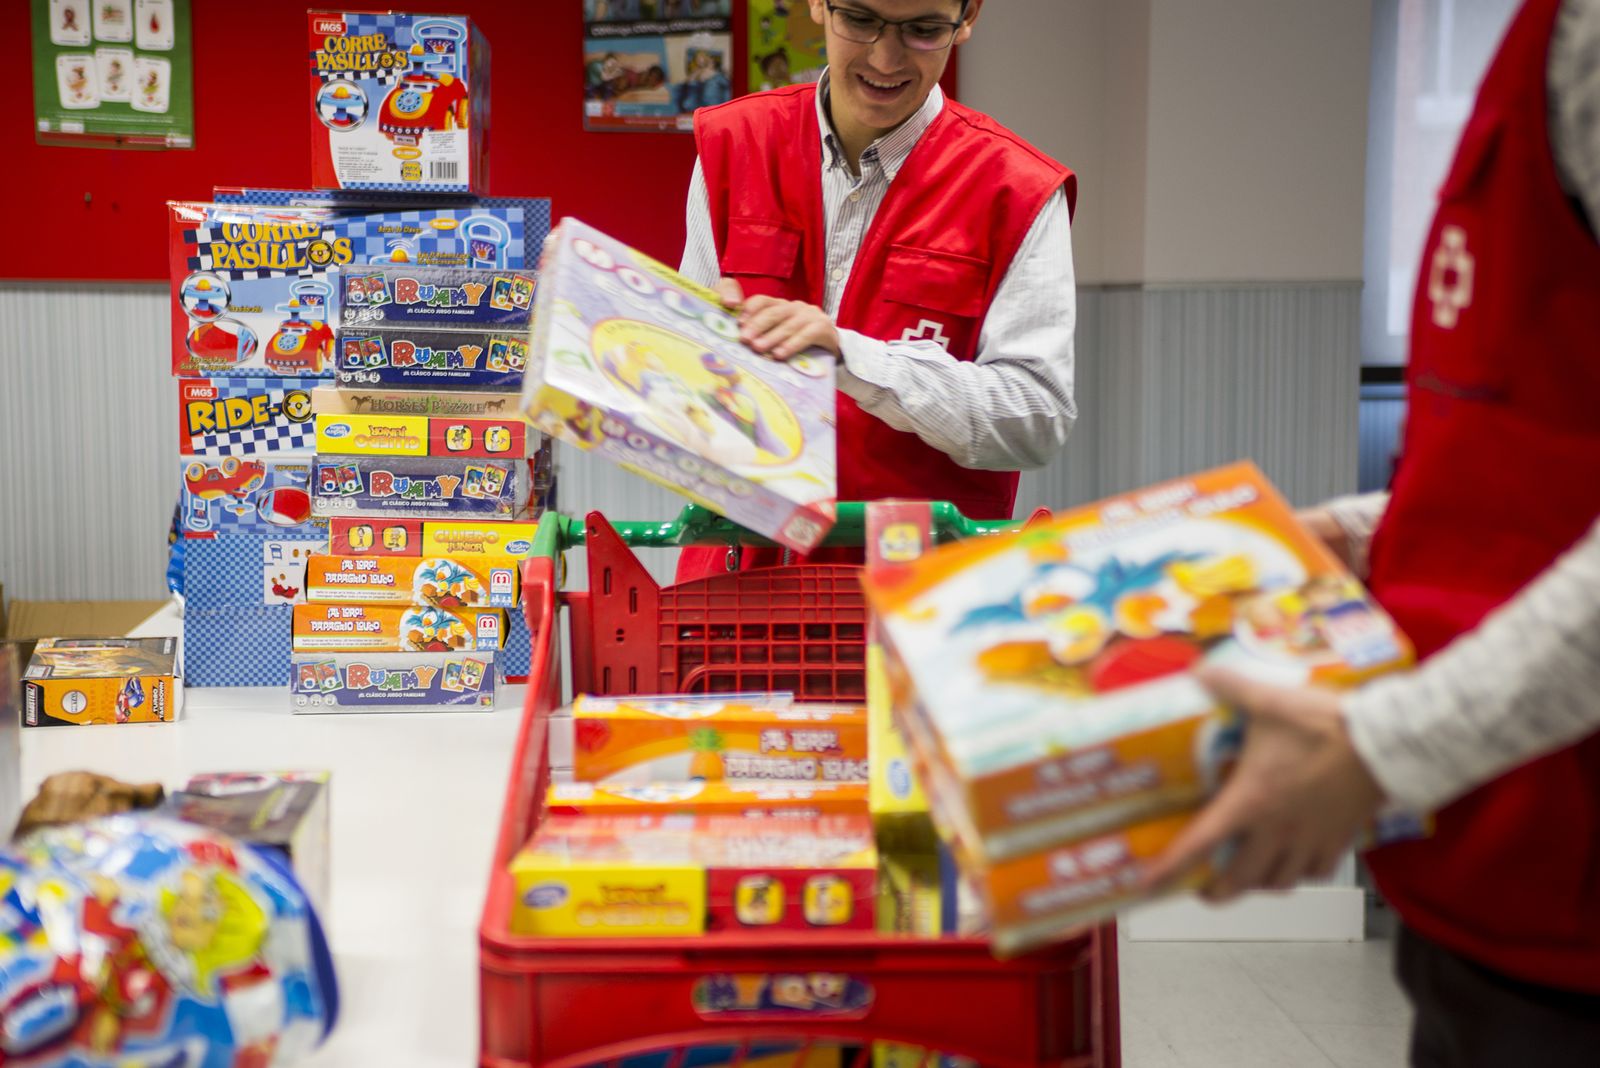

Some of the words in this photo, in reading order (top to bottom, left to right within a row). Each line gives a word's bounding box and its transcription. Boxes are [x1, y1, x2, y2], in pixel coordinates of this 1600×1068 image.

[320, 22, 342, 33] MGS
[323, 33, 387, 53] CORRE
[316, 50, 409, 71] PASILLOS
[221, 221, 321, 244] CORRE
[210, 237, 355, 271] PASILLOS
[394, 277, 488, 307] RUMMY
[391, 340, 484, 369] RUMMY
[190, 388, 213, 398] MGS
[370, 399, 427, 414] HORSES
[432, 399, 485, 415] PUZZLE
[368, 425, 407, 437] JUNIOR
[353, 434, 420, 450] CLUEDO
[369, 470, 461, 499] RUMMY
[433, 529, 499, 544] CLUEDO
[447, 542, 485, 554] JUNIOR
[346, 663, 438, 691] RUMMY
